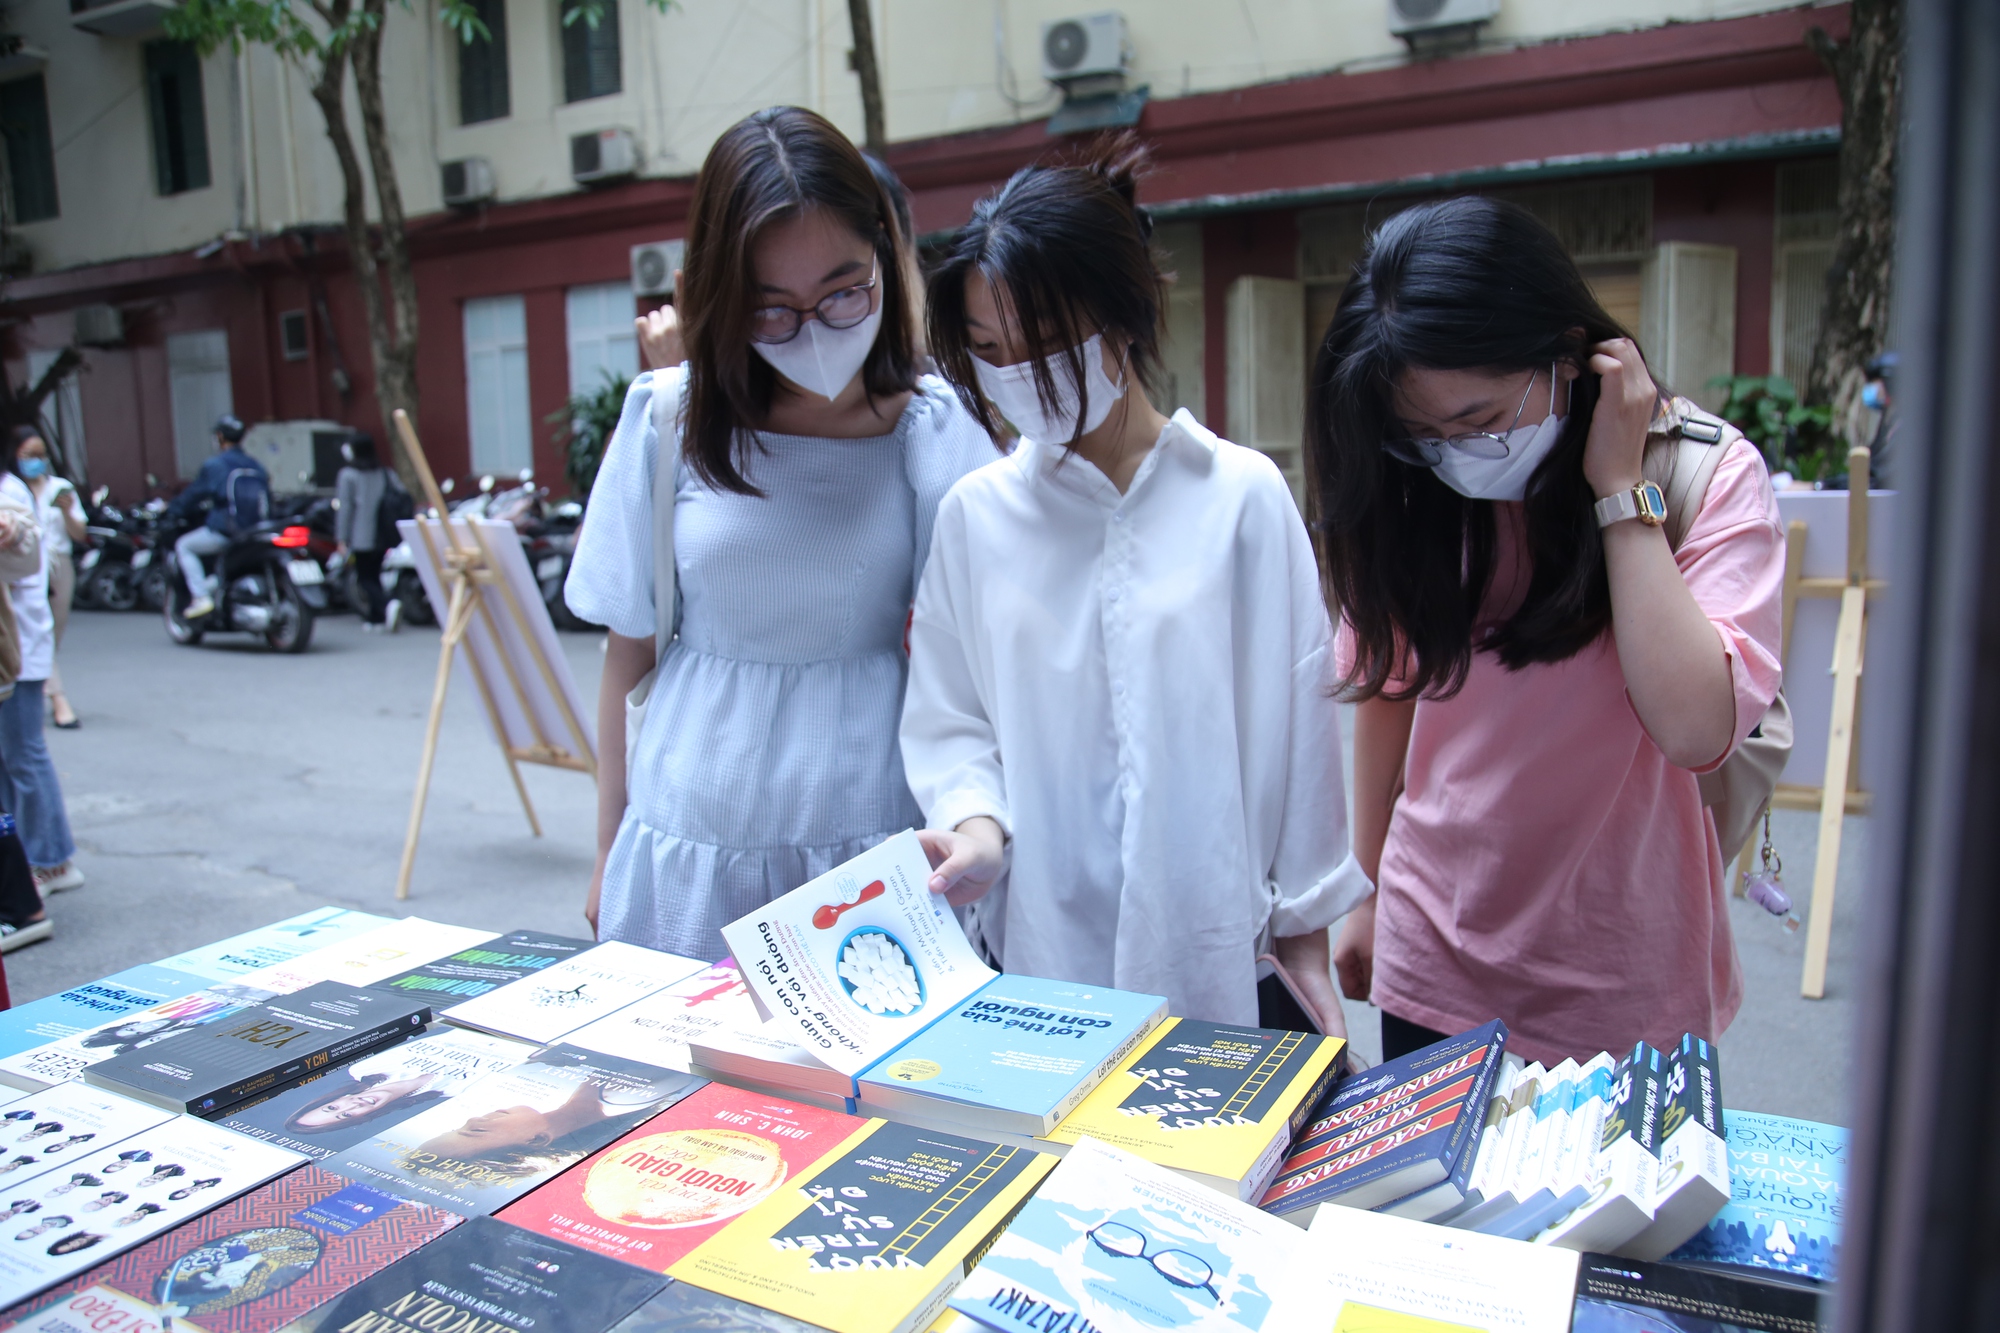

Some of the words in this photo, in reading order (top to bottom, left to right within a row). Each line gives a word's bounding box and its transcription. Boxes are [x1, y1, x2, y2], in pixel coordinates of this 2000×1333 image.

[887, 875, 906, 906] Goran
[903, 911, 927, 948] Michael
[916, 910, 932, 935] Emily
[753, 920, 791, 974] đường
[754, 958, 779, 985] nói
[72, 982, 135, 1003] người
[784, 975, 809, 1001] với
[122, 994, 160, 1008] con
[774, 987, 801, 1016] con
[966, 998, 1060, 1022] người
[953, 1010, 1015, 1027] của
[997, 1018, 1049, 1034] thế
[1055, 1013, 1114, 1030] con
[797, 1017, 833, 1050] Giúp
[1043, 1023, 1090, 1040] Lợi
[588, 1079, 658, 1099] MARIAH
[1380, 1053, 1472, 1104] THÀNH
[710, 1109, 755, 1125] SHIN
[749, 1119, 773, 1130] C.
[1307, 1095, 1381, 1136] CÔNG
[1736, 1115, 1778, 1127] Zhuo
[217, 1118, 281, 1142] Harris
[768, 1123, 814, 1140] JOHN
[1781, 1122, 1818, 1134] Julie
[268, 1134, 339, 1161] Kamala
[1740, 1139, 1823, 1159] MAKING
[434, 1158, 525, 1190] MARIAH
[614, 1150, 686, 1181] GIÀU
[1282, 1143, 1376, 1193] THANG
[417, 1184, 444, 1196] YORK
[670, 1165, 757, 1202] NGƯỜI
[441, 1192, 465, 1203] NEW
[1129, 1184, 1187, 1212] NAPIER
[544, 1212, 576, 1227] HILL
[1188, 1209, 1244, 1237] SUSAN
[570, 1220, 631, 1245] NAPOLEON
[1586, 1278, 1624, 1290] CHINA
[1588, 1284, 1621, 1296] FROM
[1627, 1285, 1640, 1293] IN
[1626, 1290, 1696, 1312] EXPERIENCE
[1680, 1296, 1736, 1313] LEADING
